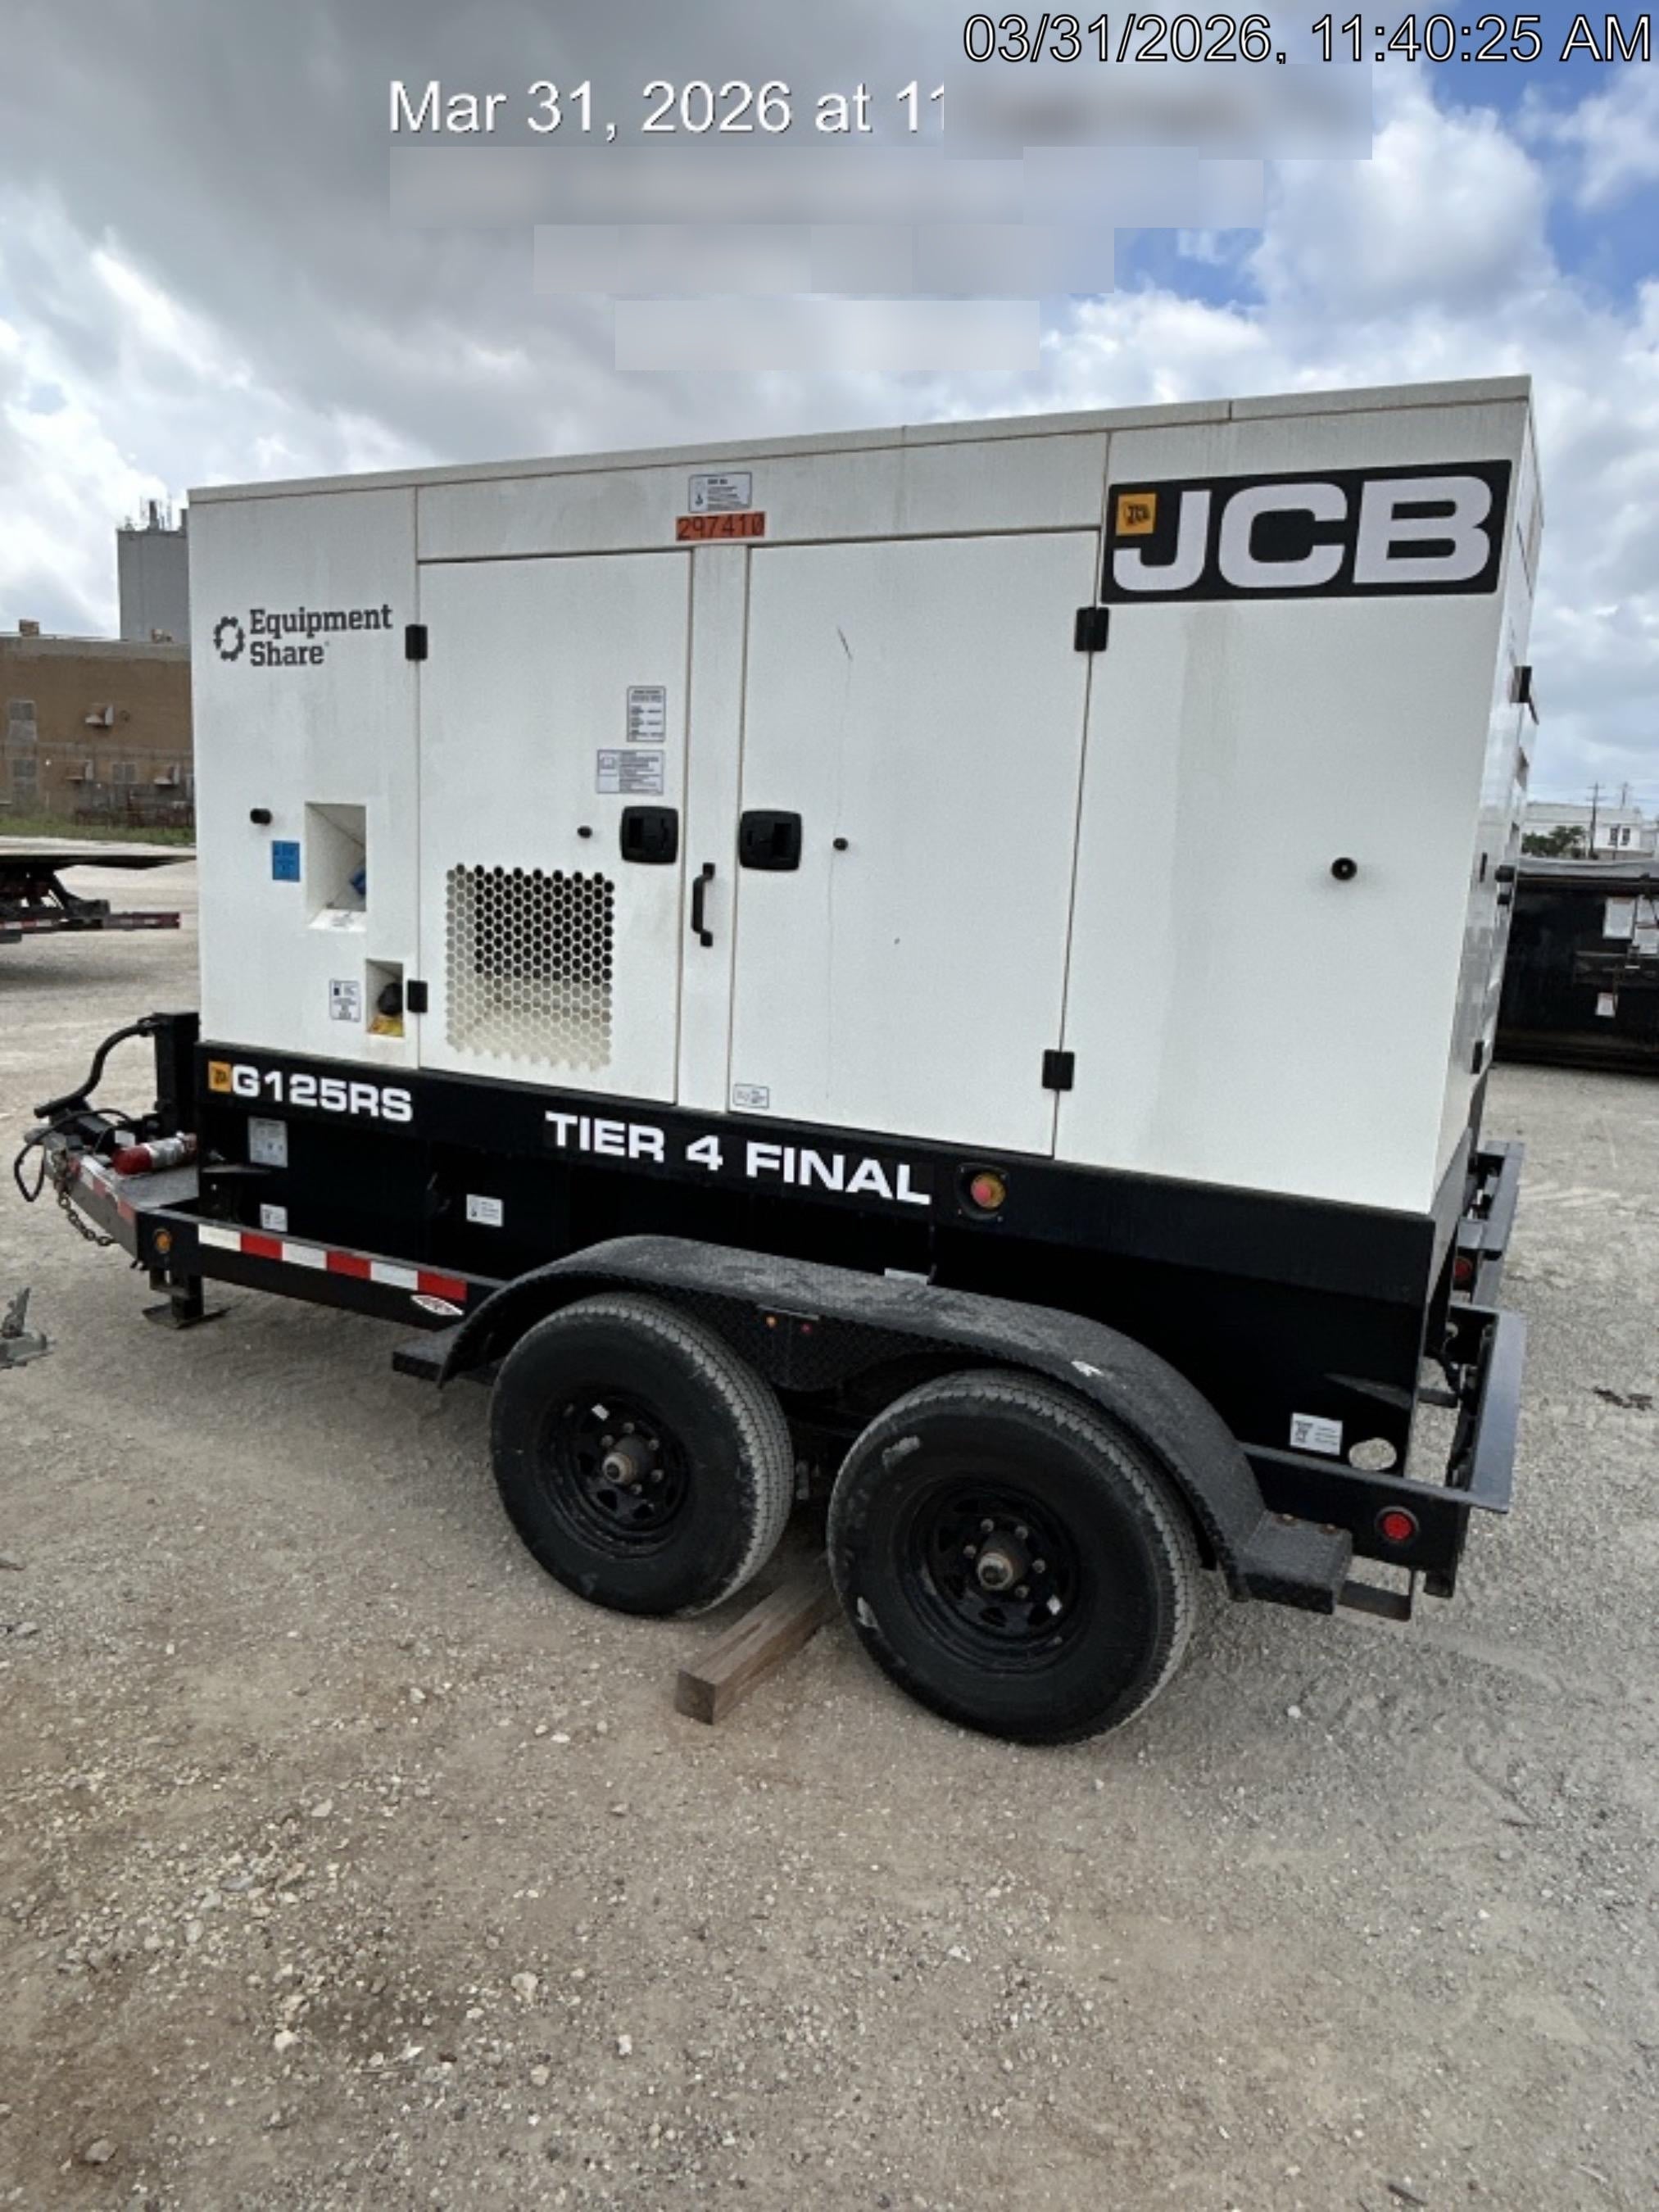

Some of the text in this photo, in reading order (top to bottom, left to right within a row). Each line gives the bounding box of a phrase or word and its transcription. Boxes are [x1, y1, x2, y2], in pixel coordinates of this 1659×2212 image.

[677, 514, 764, 541] 297410
[1113, 476, 1493, 592] JCB
[249, 604, 393, 639] Equipment
[250, 641, 324, 667] Share
[232, 1064, 413, 1122] G125RS
[545, 1110, 931, 1205] TIER 4 FINAL
